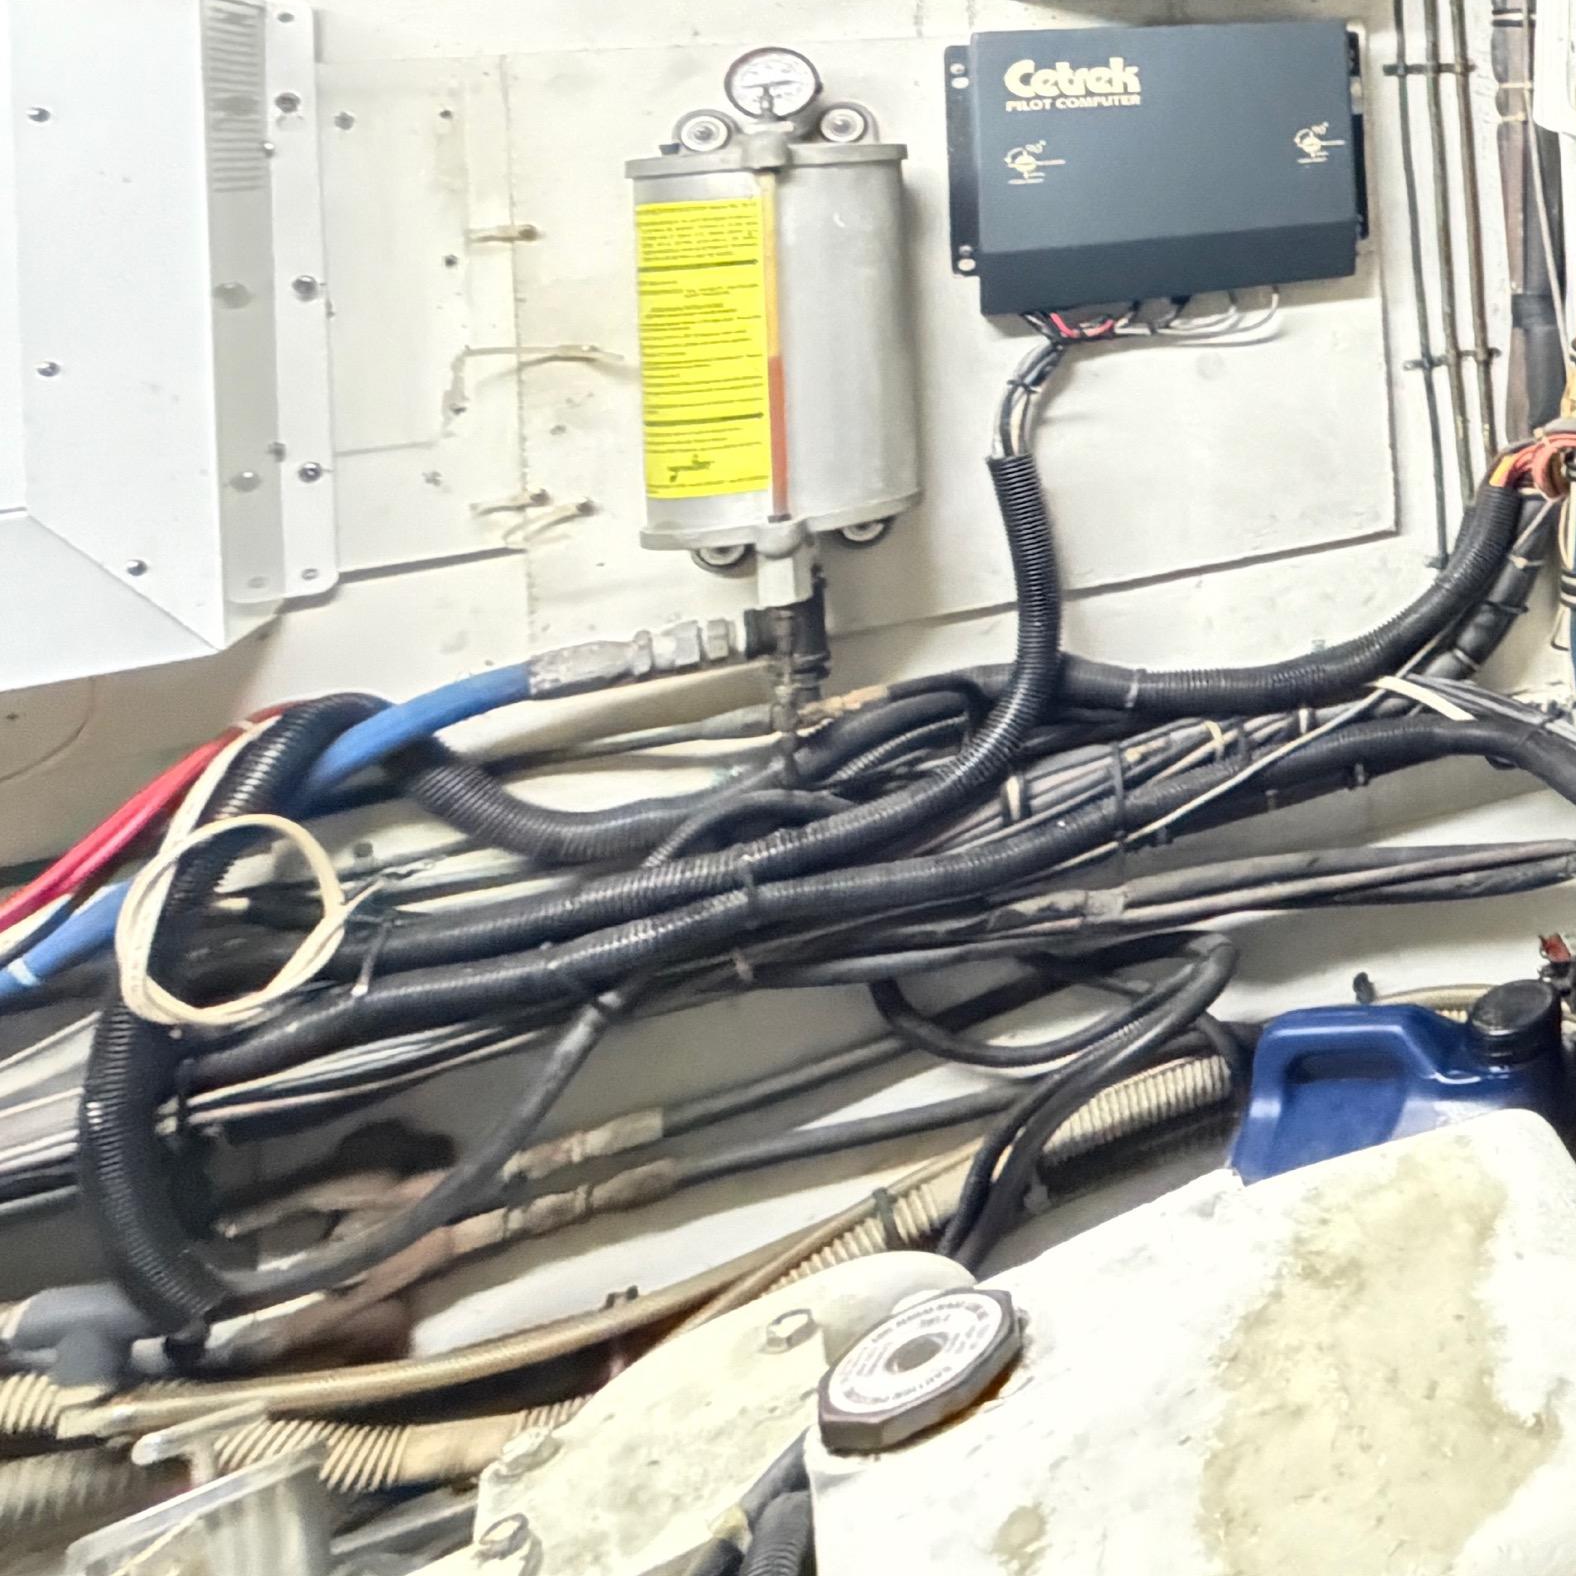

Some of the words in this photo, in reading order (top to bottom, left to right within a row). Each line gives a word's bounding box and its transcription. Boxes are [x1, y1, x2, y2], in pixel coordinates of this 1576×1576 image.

[1004, 57, 1141, 97] Cetrek
[1006, 98, 1052, 111] PILOT
[1055, 93, 1141, 109] COMPUTER
